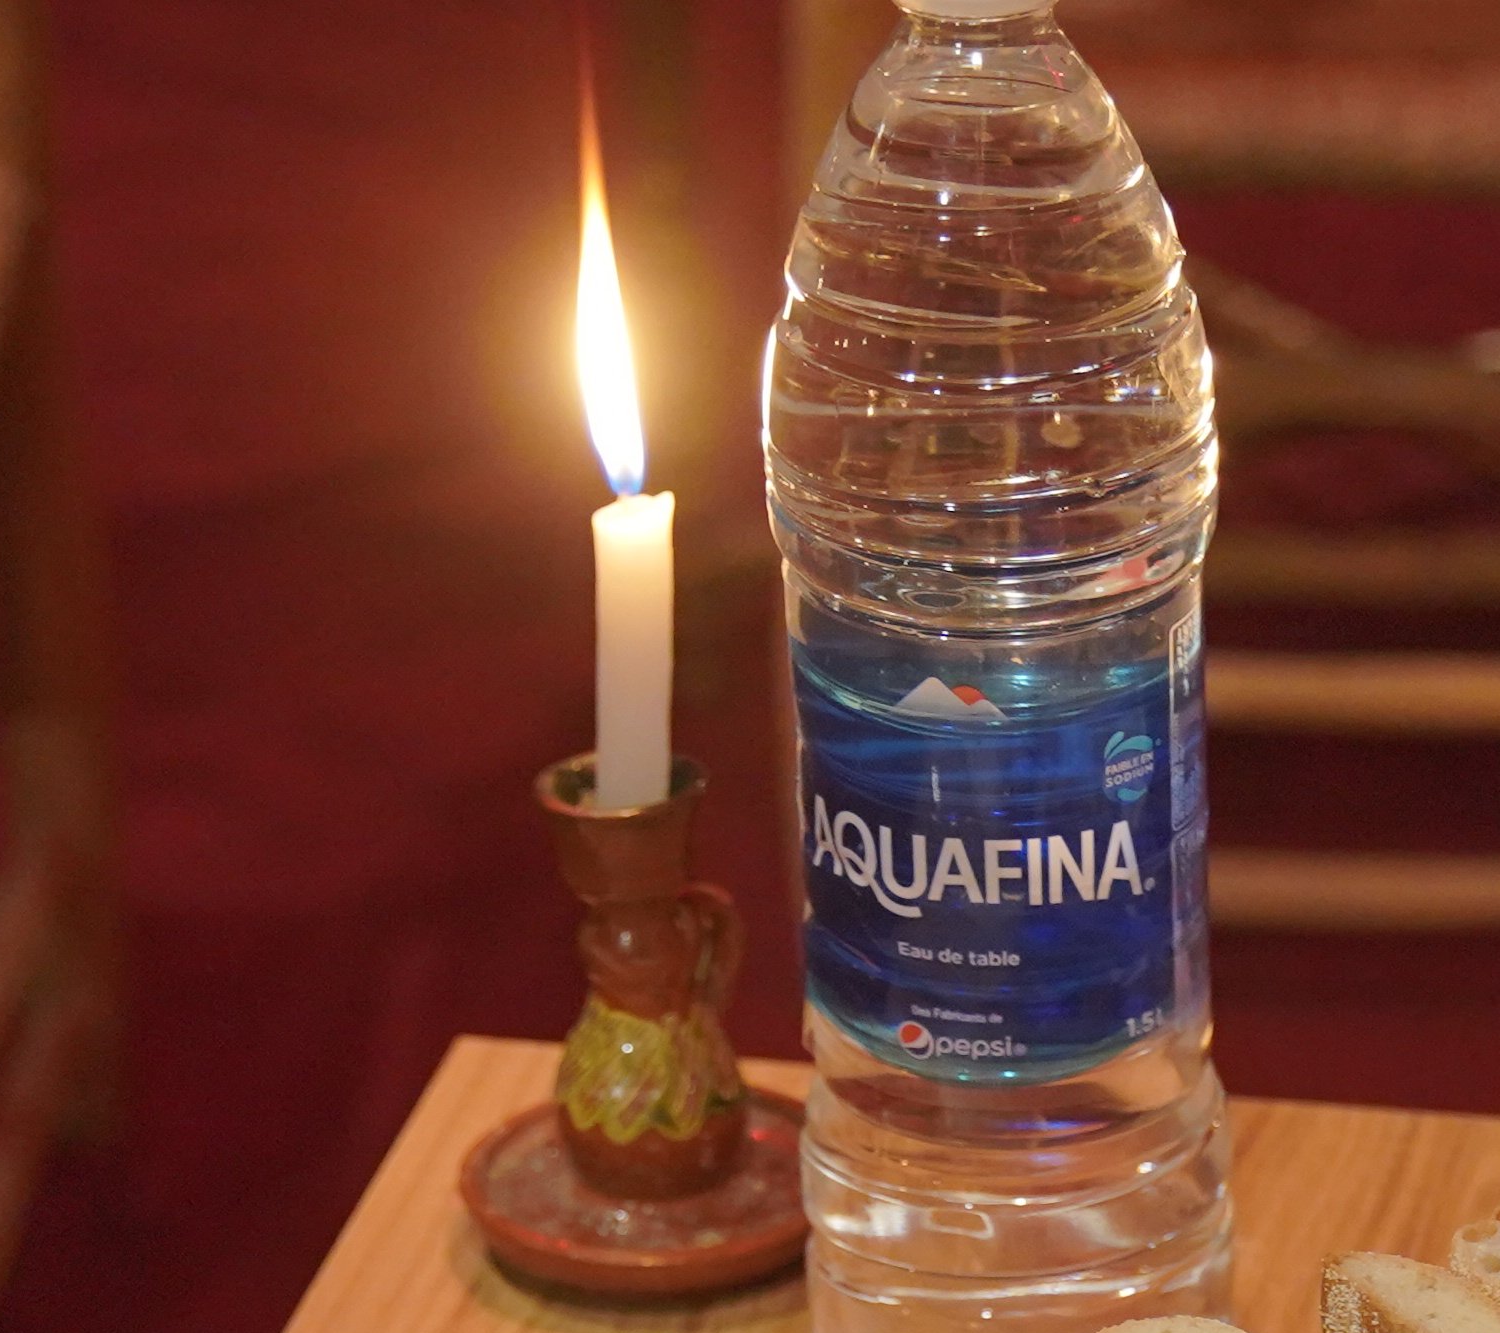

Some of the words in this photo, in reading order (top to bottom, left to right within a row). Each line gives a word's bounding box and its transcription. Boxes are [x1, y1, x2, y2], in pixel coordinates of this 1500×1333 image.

[1105, 761, 1154, 788] SODIUM
[813, 794, 1143, 918] AQUAFINA
[897, 941, 933, 961] Eau
[938, 948, 964, 965] de
[969, 951, 1021, 967] table
[936, 1036, 1013, 1060] pepsi
